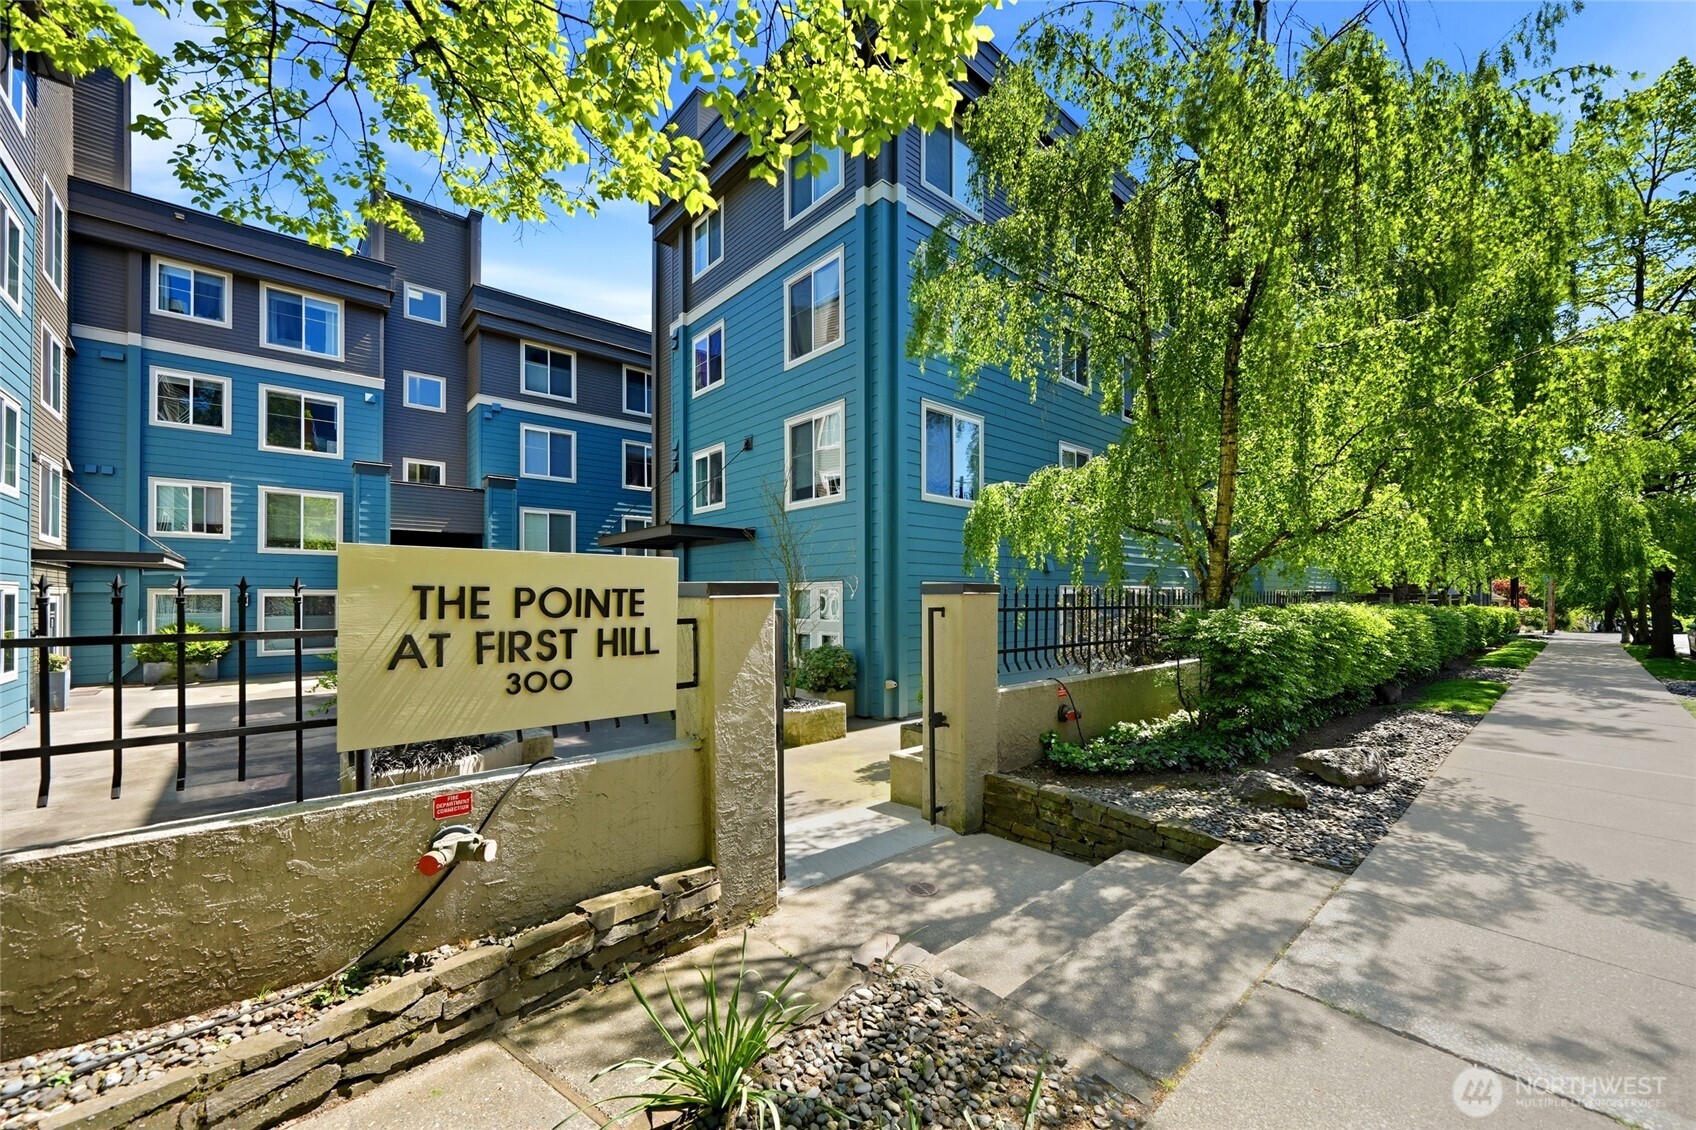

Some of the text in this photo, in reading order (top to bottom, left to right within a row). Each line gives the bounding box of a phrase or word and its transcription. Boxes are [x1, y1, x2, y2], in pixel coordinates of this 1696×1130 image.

[412, 585, 645, 620] THE POINTE
[387, 627, 660, 670] AT FIRST HILL
[505, 669, 573, 695] 300
[435, 798, 470, 809] DEPARTMENT
[436, 804, 469, 815] CONNECTION
